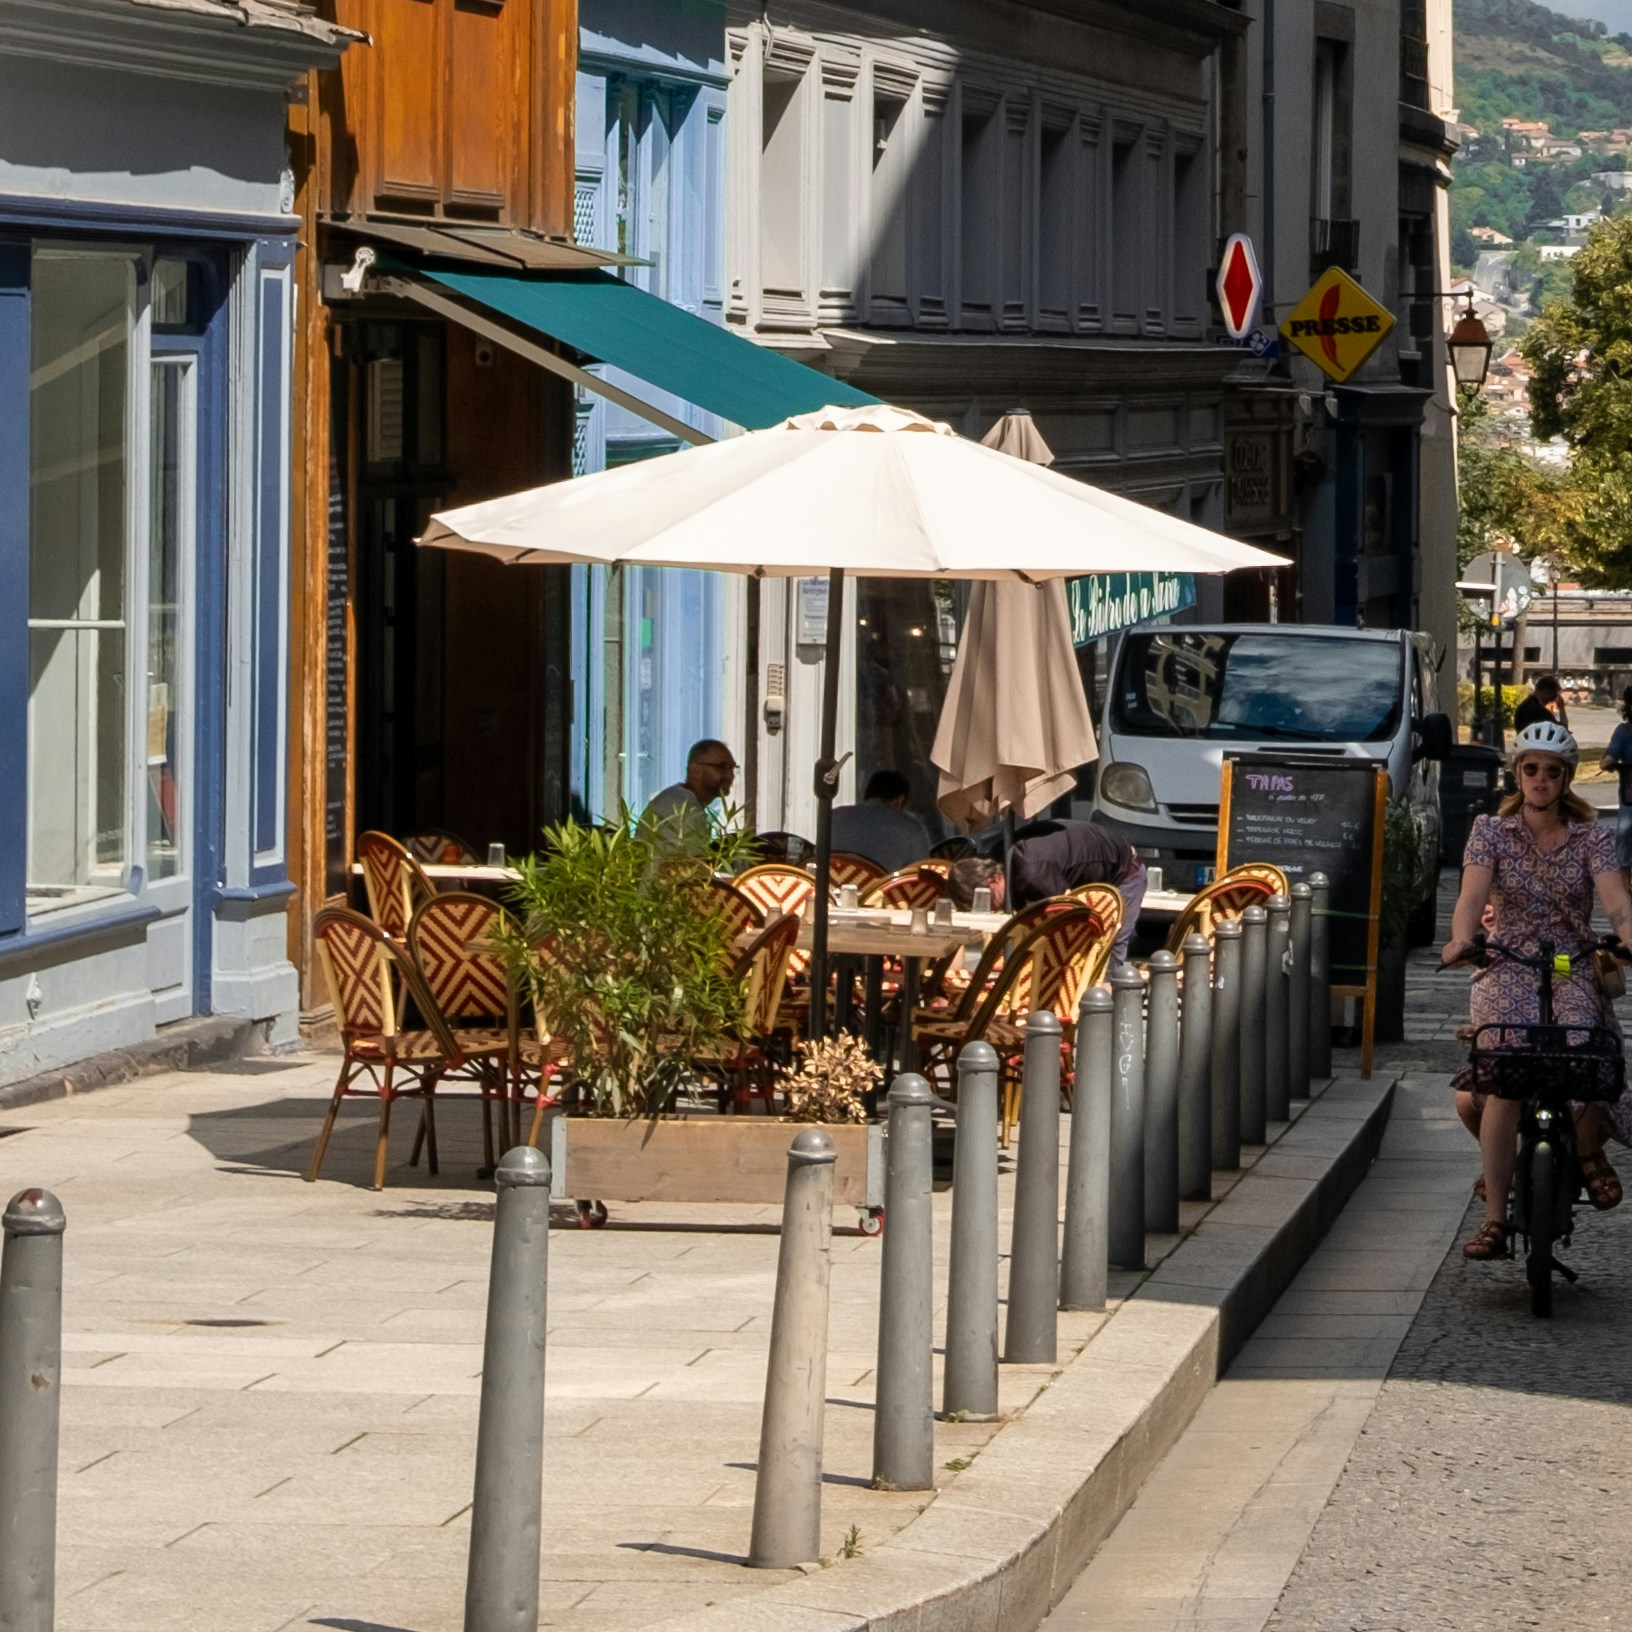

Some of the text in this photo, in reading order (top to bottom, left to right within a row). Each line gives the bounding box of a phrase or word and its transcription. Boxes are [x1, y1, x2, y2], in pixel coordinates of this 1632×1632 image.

[1289, 315, 1382, 337] PRESSE
[1088, 574, 1122, 637] Bistro
[1123, 572, 1138, 626] de
[1245, 774, 1293, 791] TAPAS
